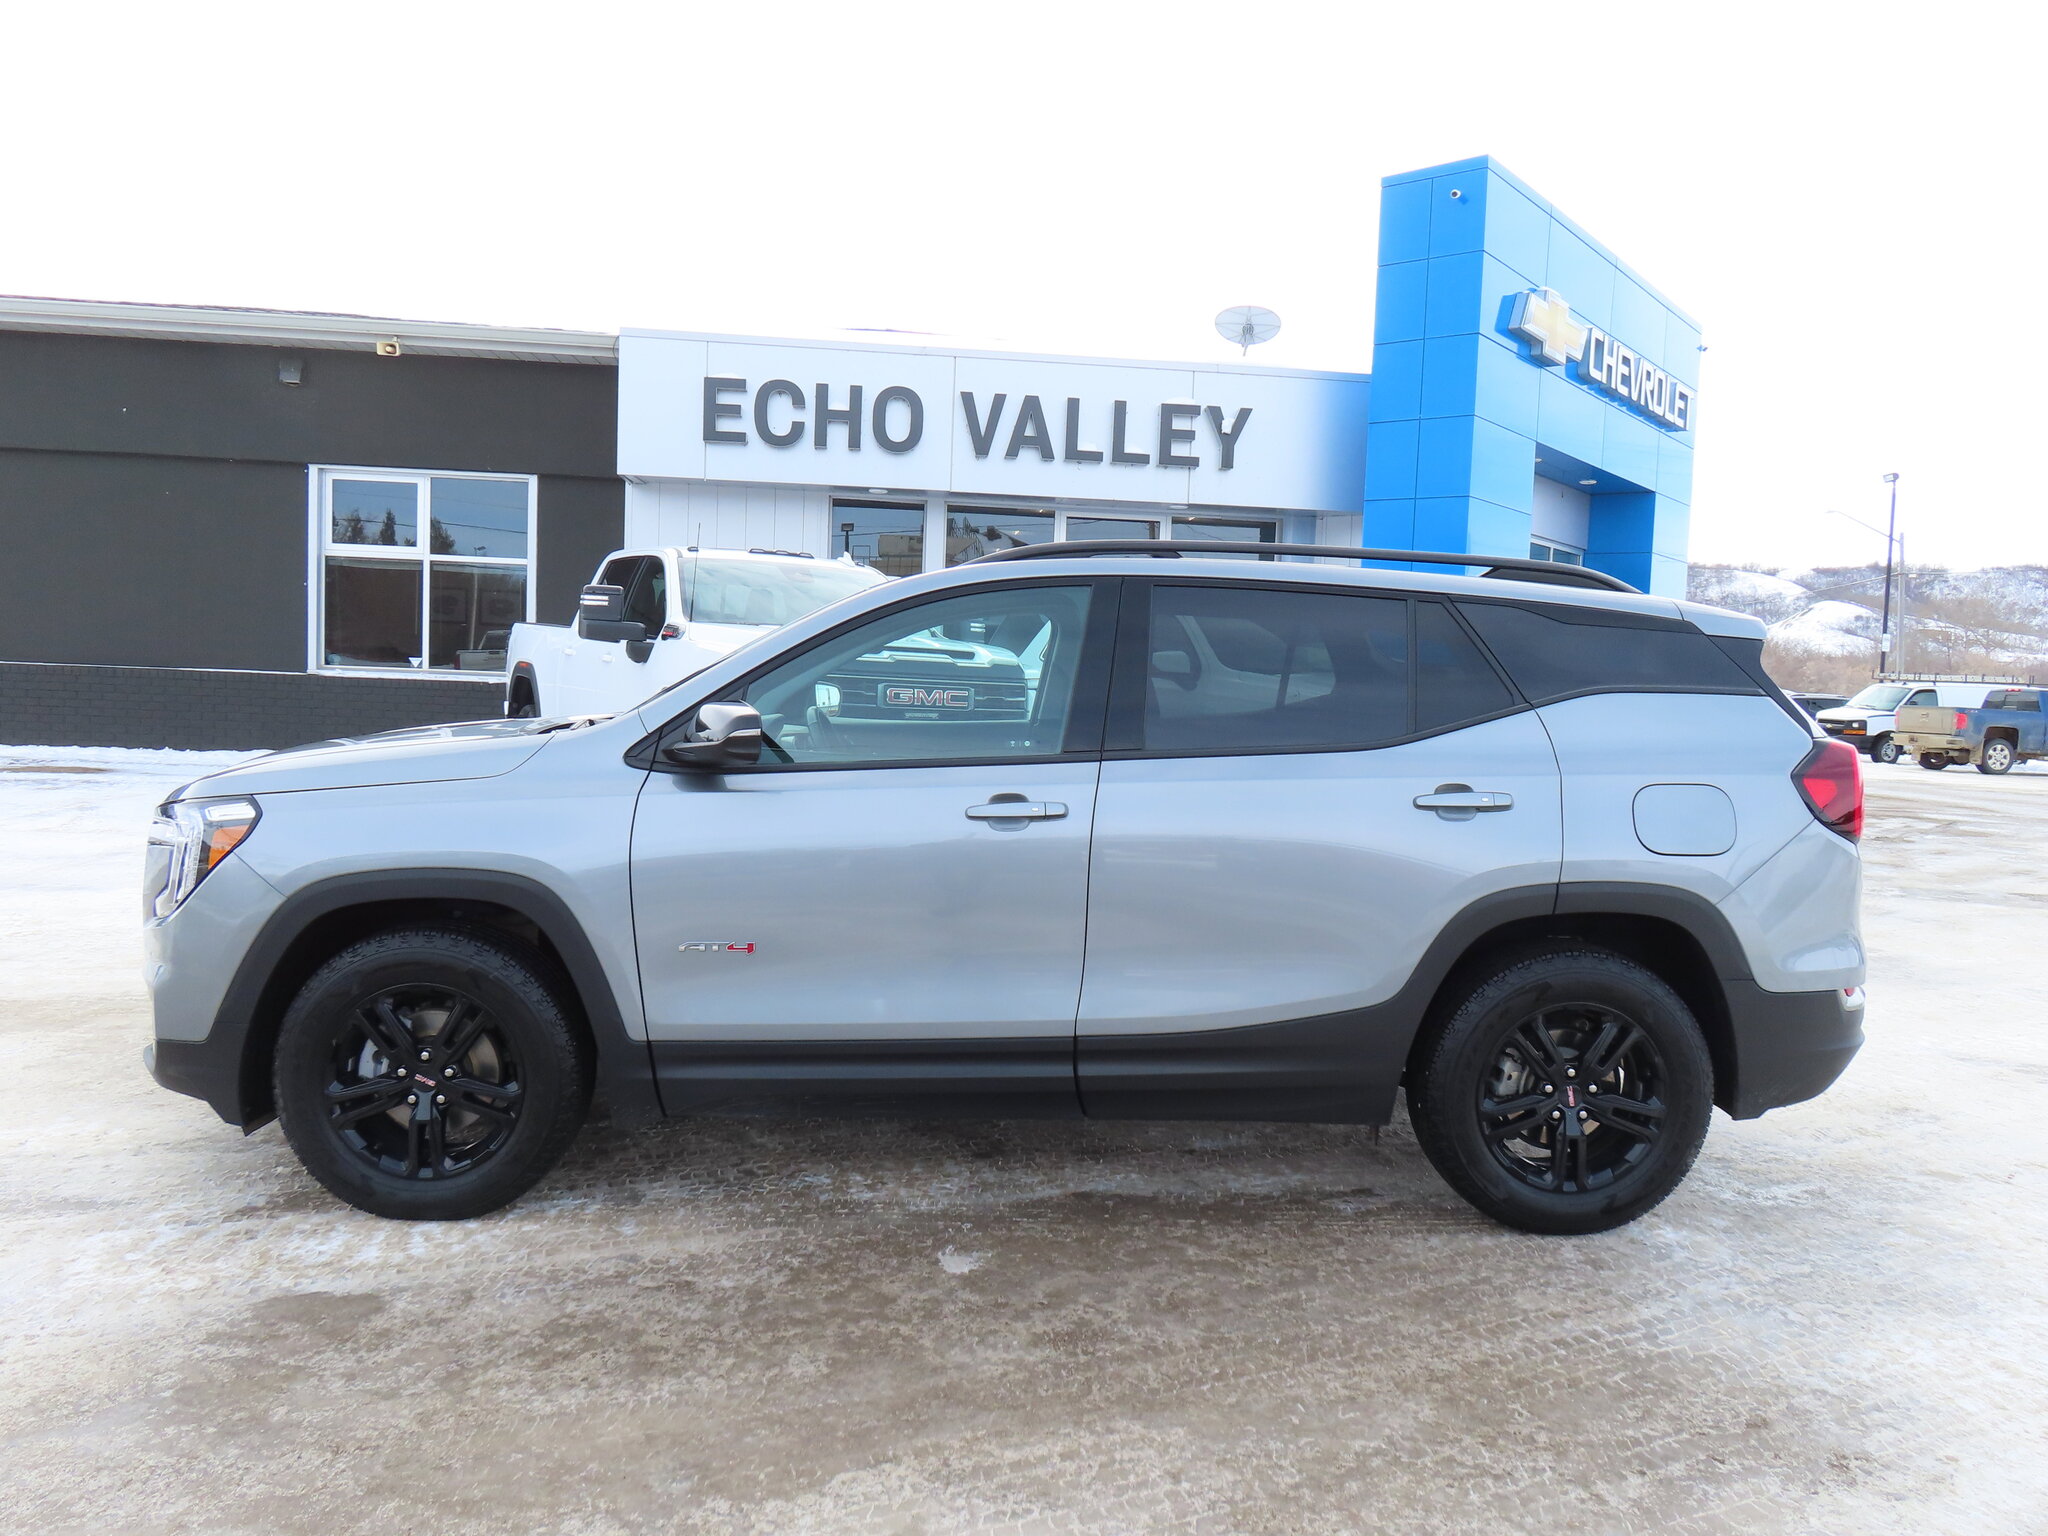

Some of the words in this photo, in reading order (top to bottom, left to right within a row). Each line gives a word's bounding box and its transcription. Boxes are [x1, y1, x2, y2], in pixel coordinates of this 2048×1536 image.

[1584, 326, 1694, 432] CHEVROLET
[703, 376, 925, 454] ECHO
[959, 391, 1254, 471] VALLEY
[886, 687, 969, 707] GMC
[678, 941, 756, 955] AT4
